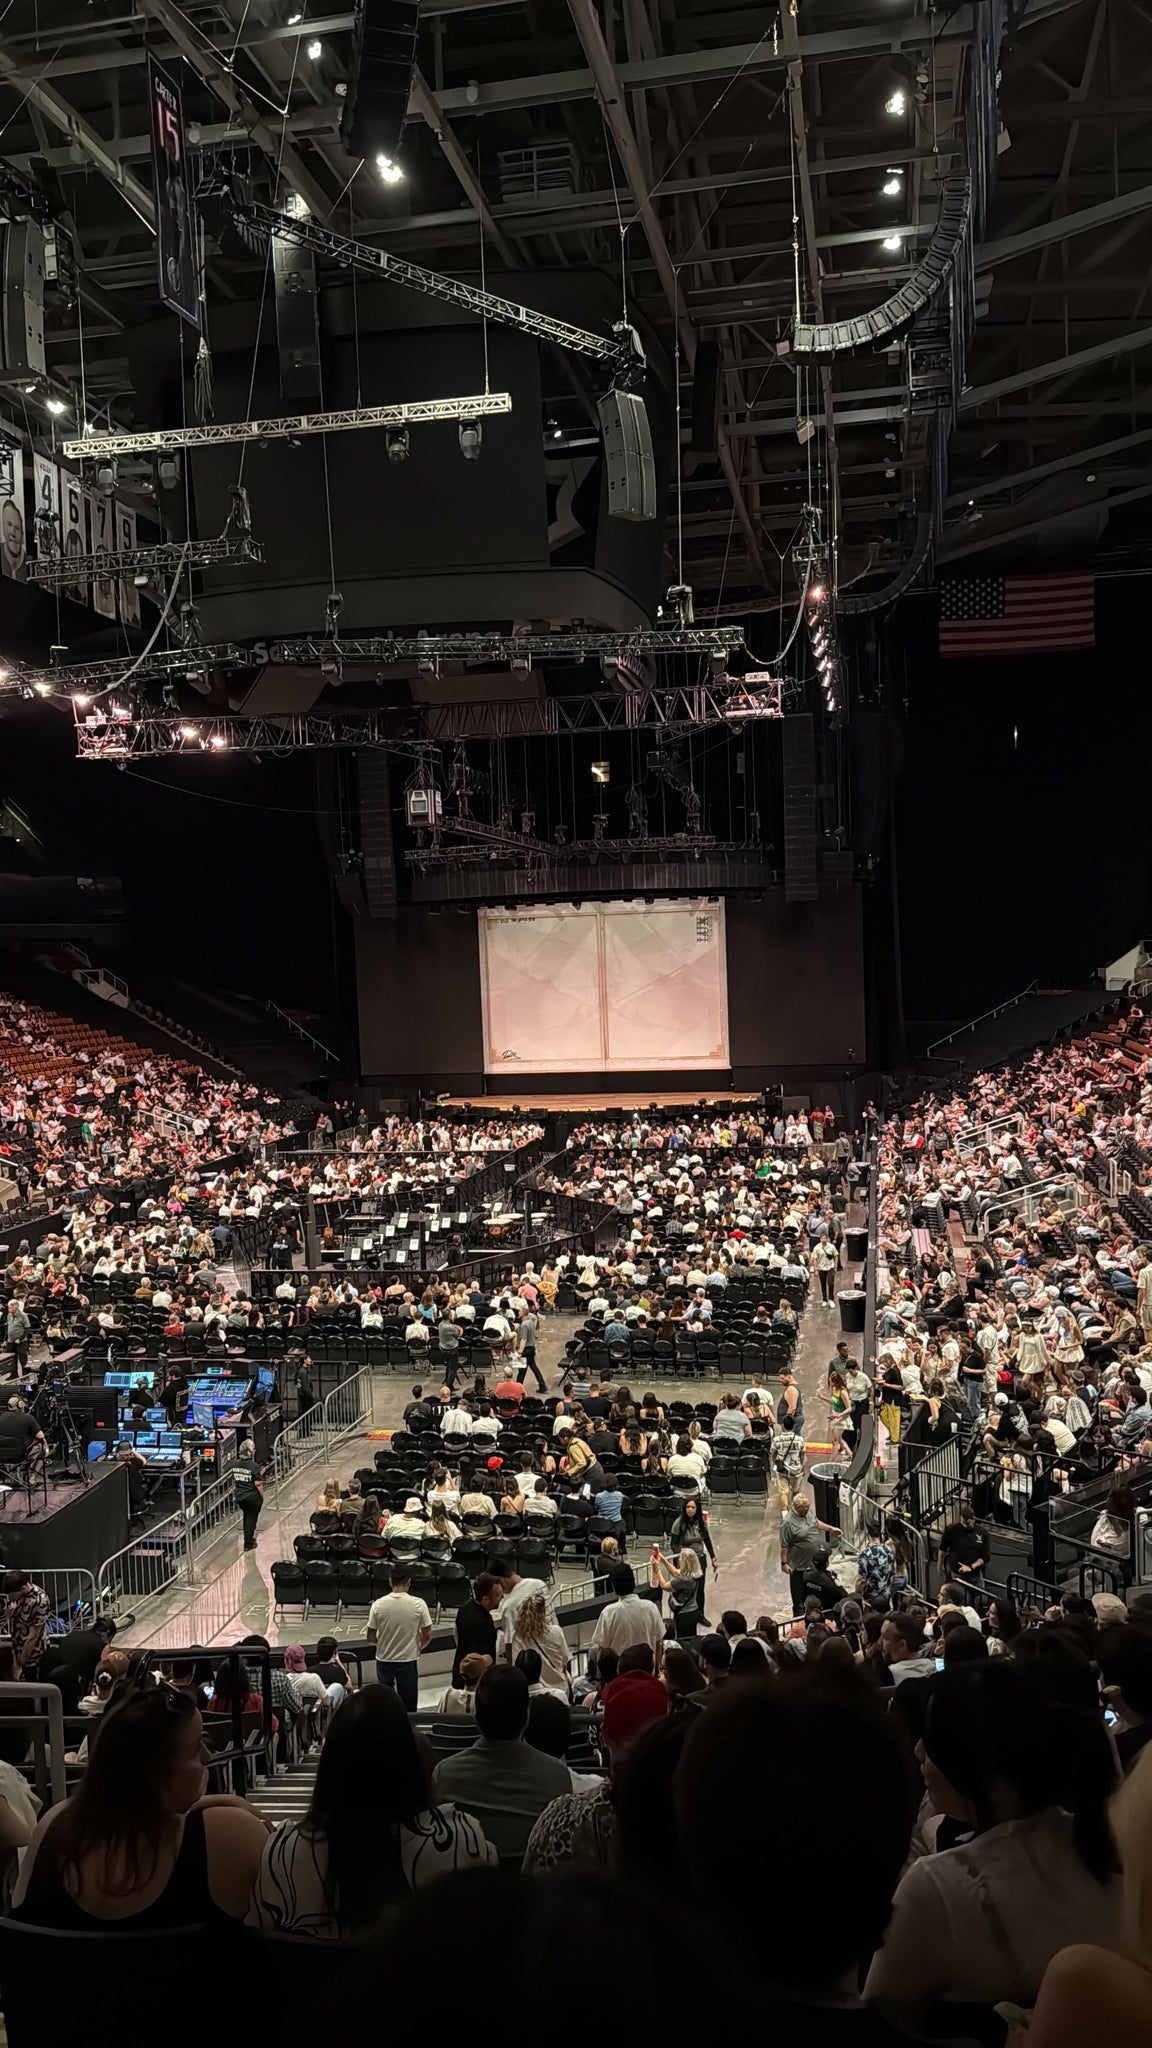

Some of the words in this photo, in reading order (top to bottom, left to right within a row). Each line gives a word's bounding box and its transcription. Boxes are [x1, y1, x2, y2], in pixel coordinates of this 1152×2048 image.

[157, 97, 180, 161] 15
[42, 474, 52, 512] 4
[69, 488, 79, 524] 6
[97, 505, 106, 538] 7
[122, 518, 131, 550] 9
